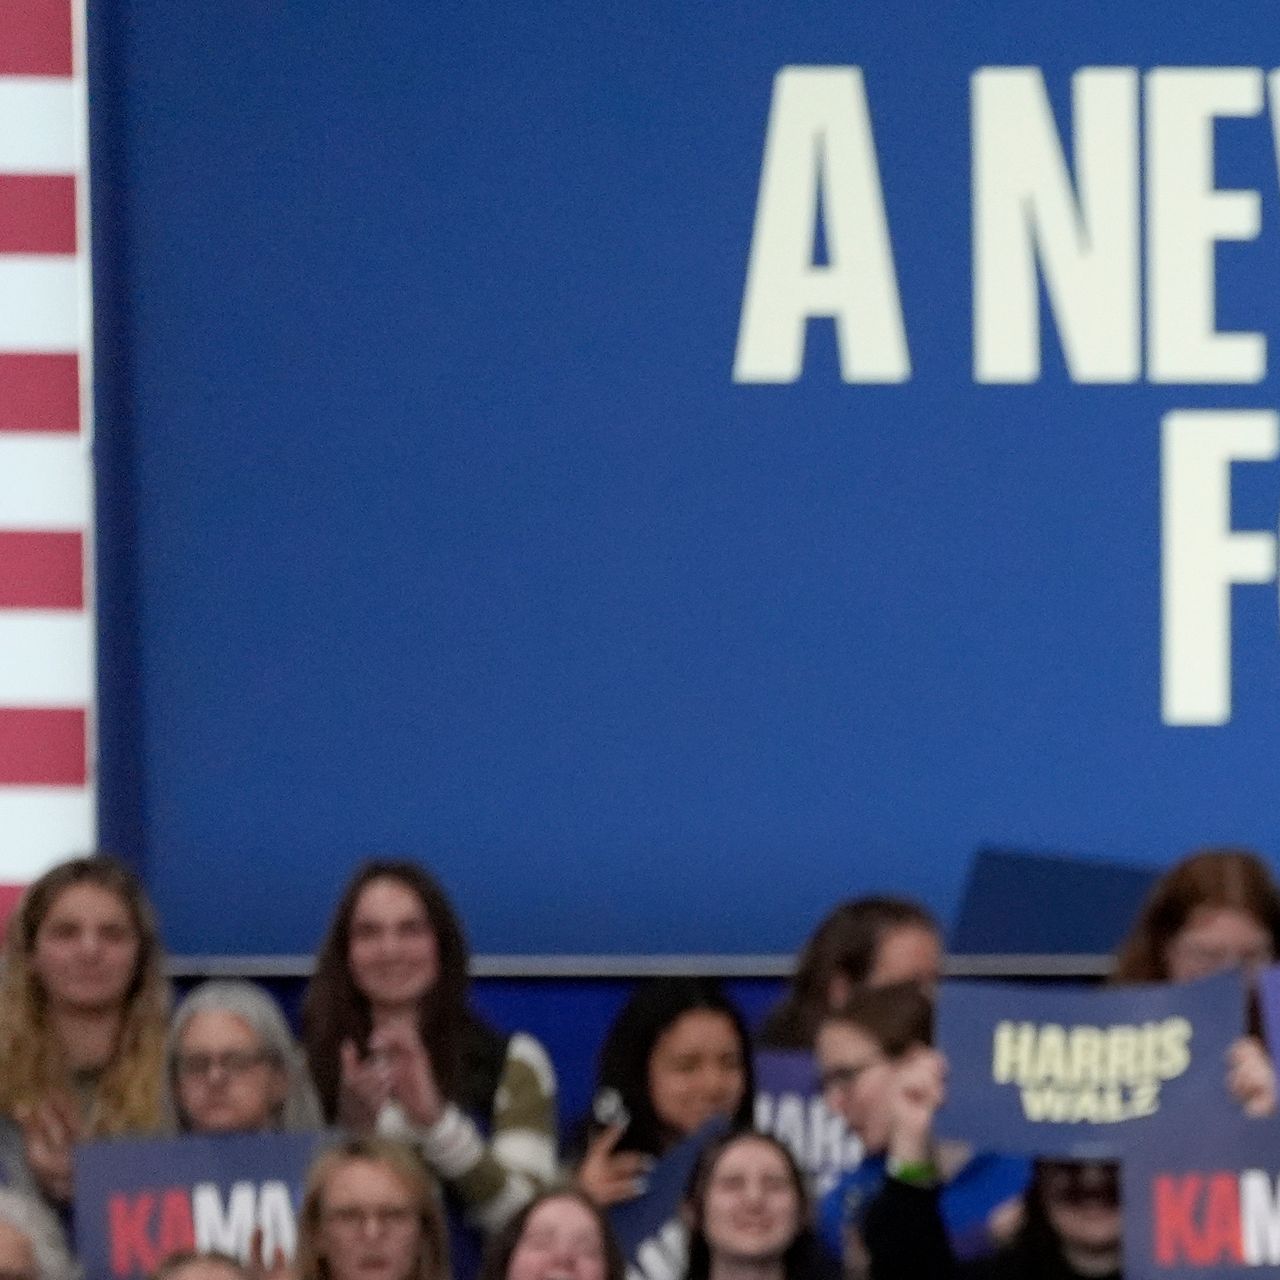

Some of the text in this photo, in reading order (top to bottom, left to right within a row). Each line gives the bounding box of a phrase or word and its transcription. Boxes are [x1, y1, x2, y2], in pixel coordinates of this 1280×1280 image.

[732, 64, 911, 383] A
[993, 1015, 1192, 1085] HARRIS
[1019, 1080, 1161, 1123] WALZ
[108, 1180, 299, 1280] KAMA
